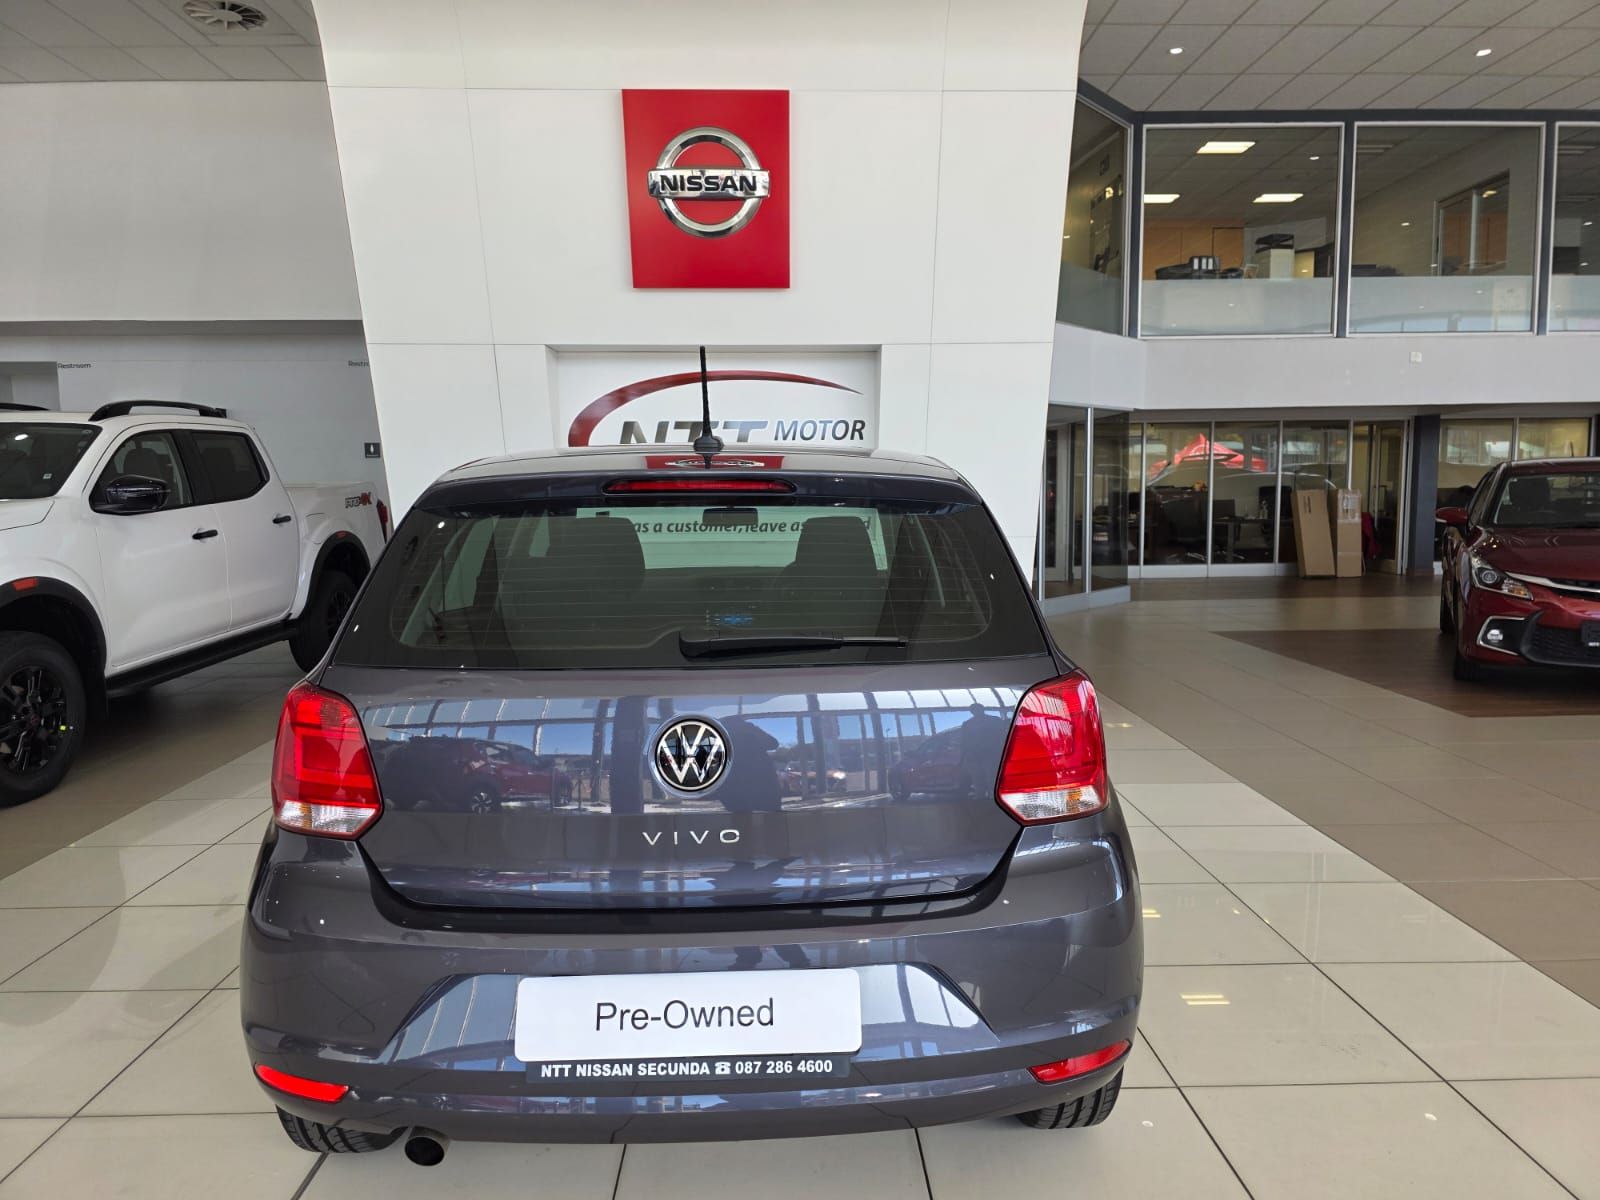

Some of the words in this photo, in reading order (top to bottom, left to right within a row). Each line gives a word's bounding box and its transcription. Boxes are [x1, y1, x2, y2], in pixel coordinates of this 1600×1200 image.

[659, 174, 757, 192] NISSAN
[619, 420, 769, 444] NTT
[774, 419, 867, 441] MOTOR
[653, 522, 663, 533] a
[642, 828, 740, 846] VIVO
[595, 997, 775, 1032] Pre-Owned
[540, 1064, 572, 1078] NTT
[575, 1063, 633, 1077] NISSAN
[637, 1062, 711, 1076] SECUNDA
[735, 1061, 762, 1074] 087
[766, 1060, 793, 1074] 286
[797, 1059, 833, 1073] 4600
